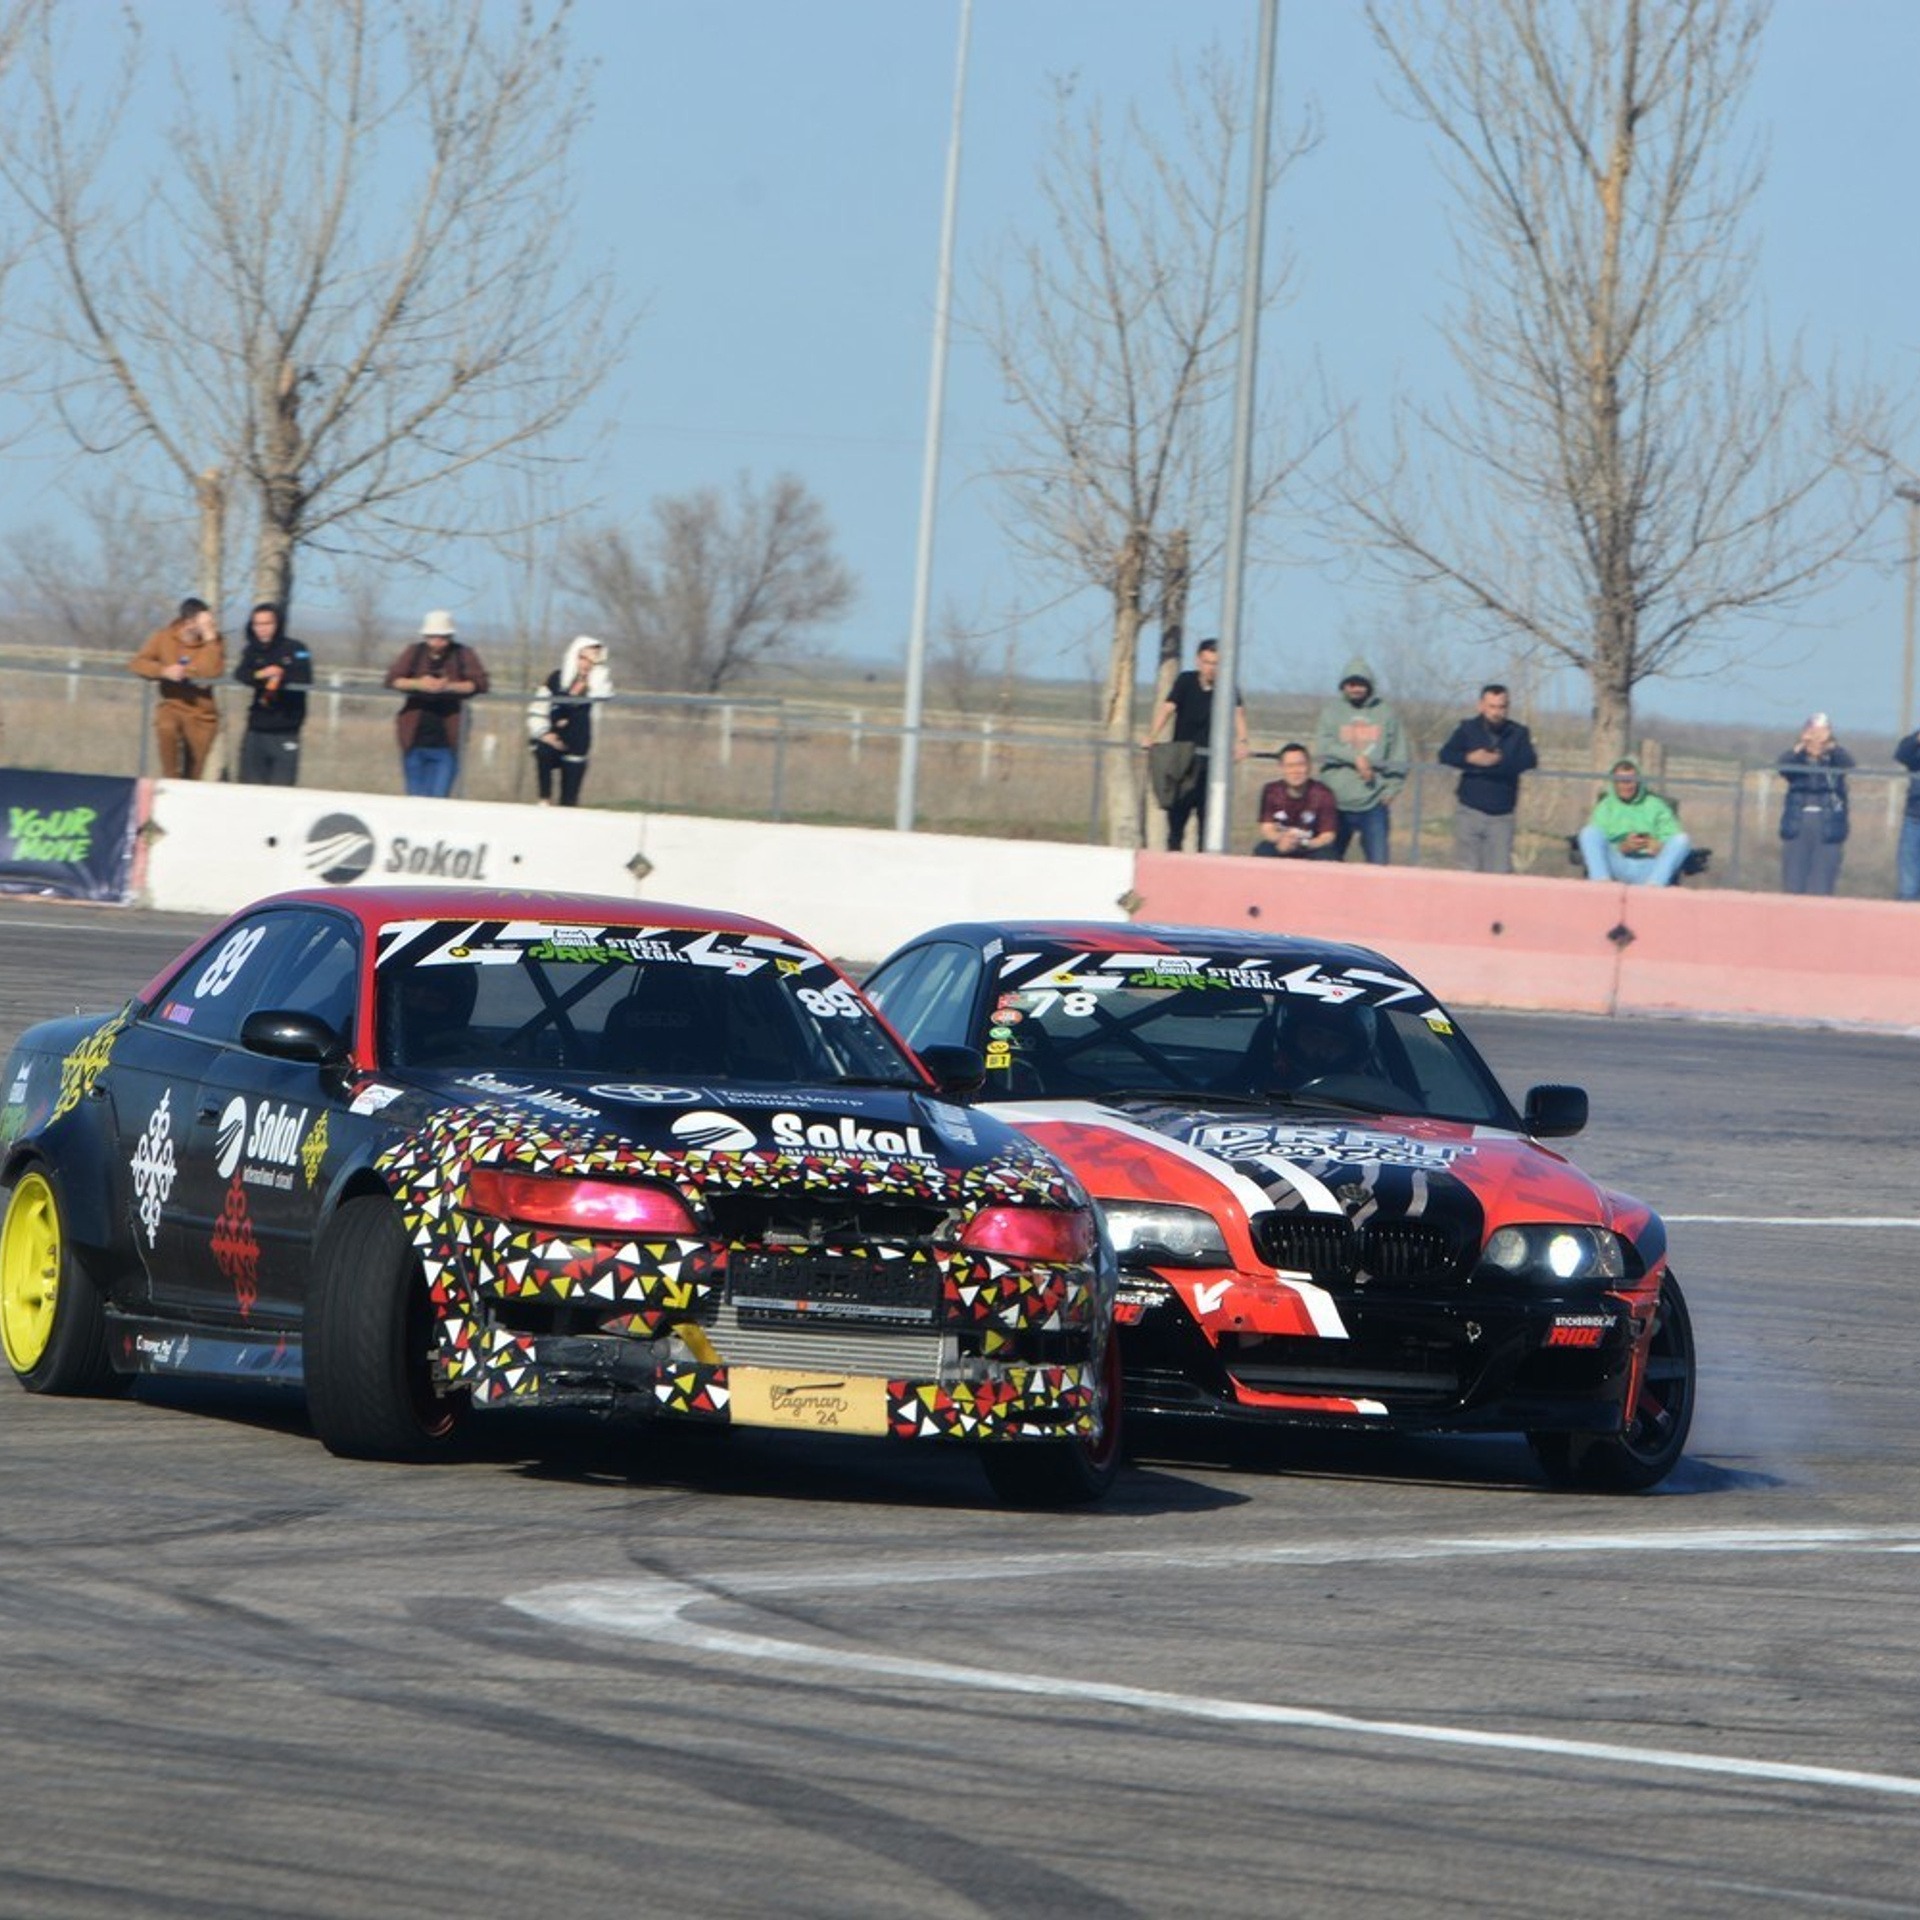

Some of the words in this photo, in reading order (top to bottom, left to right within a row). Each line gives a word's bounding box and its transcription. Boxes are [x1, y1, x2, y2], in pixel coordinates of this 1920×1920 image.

[8, 806, 97, 838] YOUR
[605, 938, 671, 951] STREET
[194, 925, 267, 999] 89
[632, 949, 689, 962] LEGAL
[1205, 967, 1272, 981] STREET
[1231, 978, 1287, 990] LEGAL
[796, 988, 862, 1018] 89
[1027, 989, 1099, 1018] 78
[1548, 1327, 1602, 1346] RIDE
[816, 1410, 838, 1425] 24
